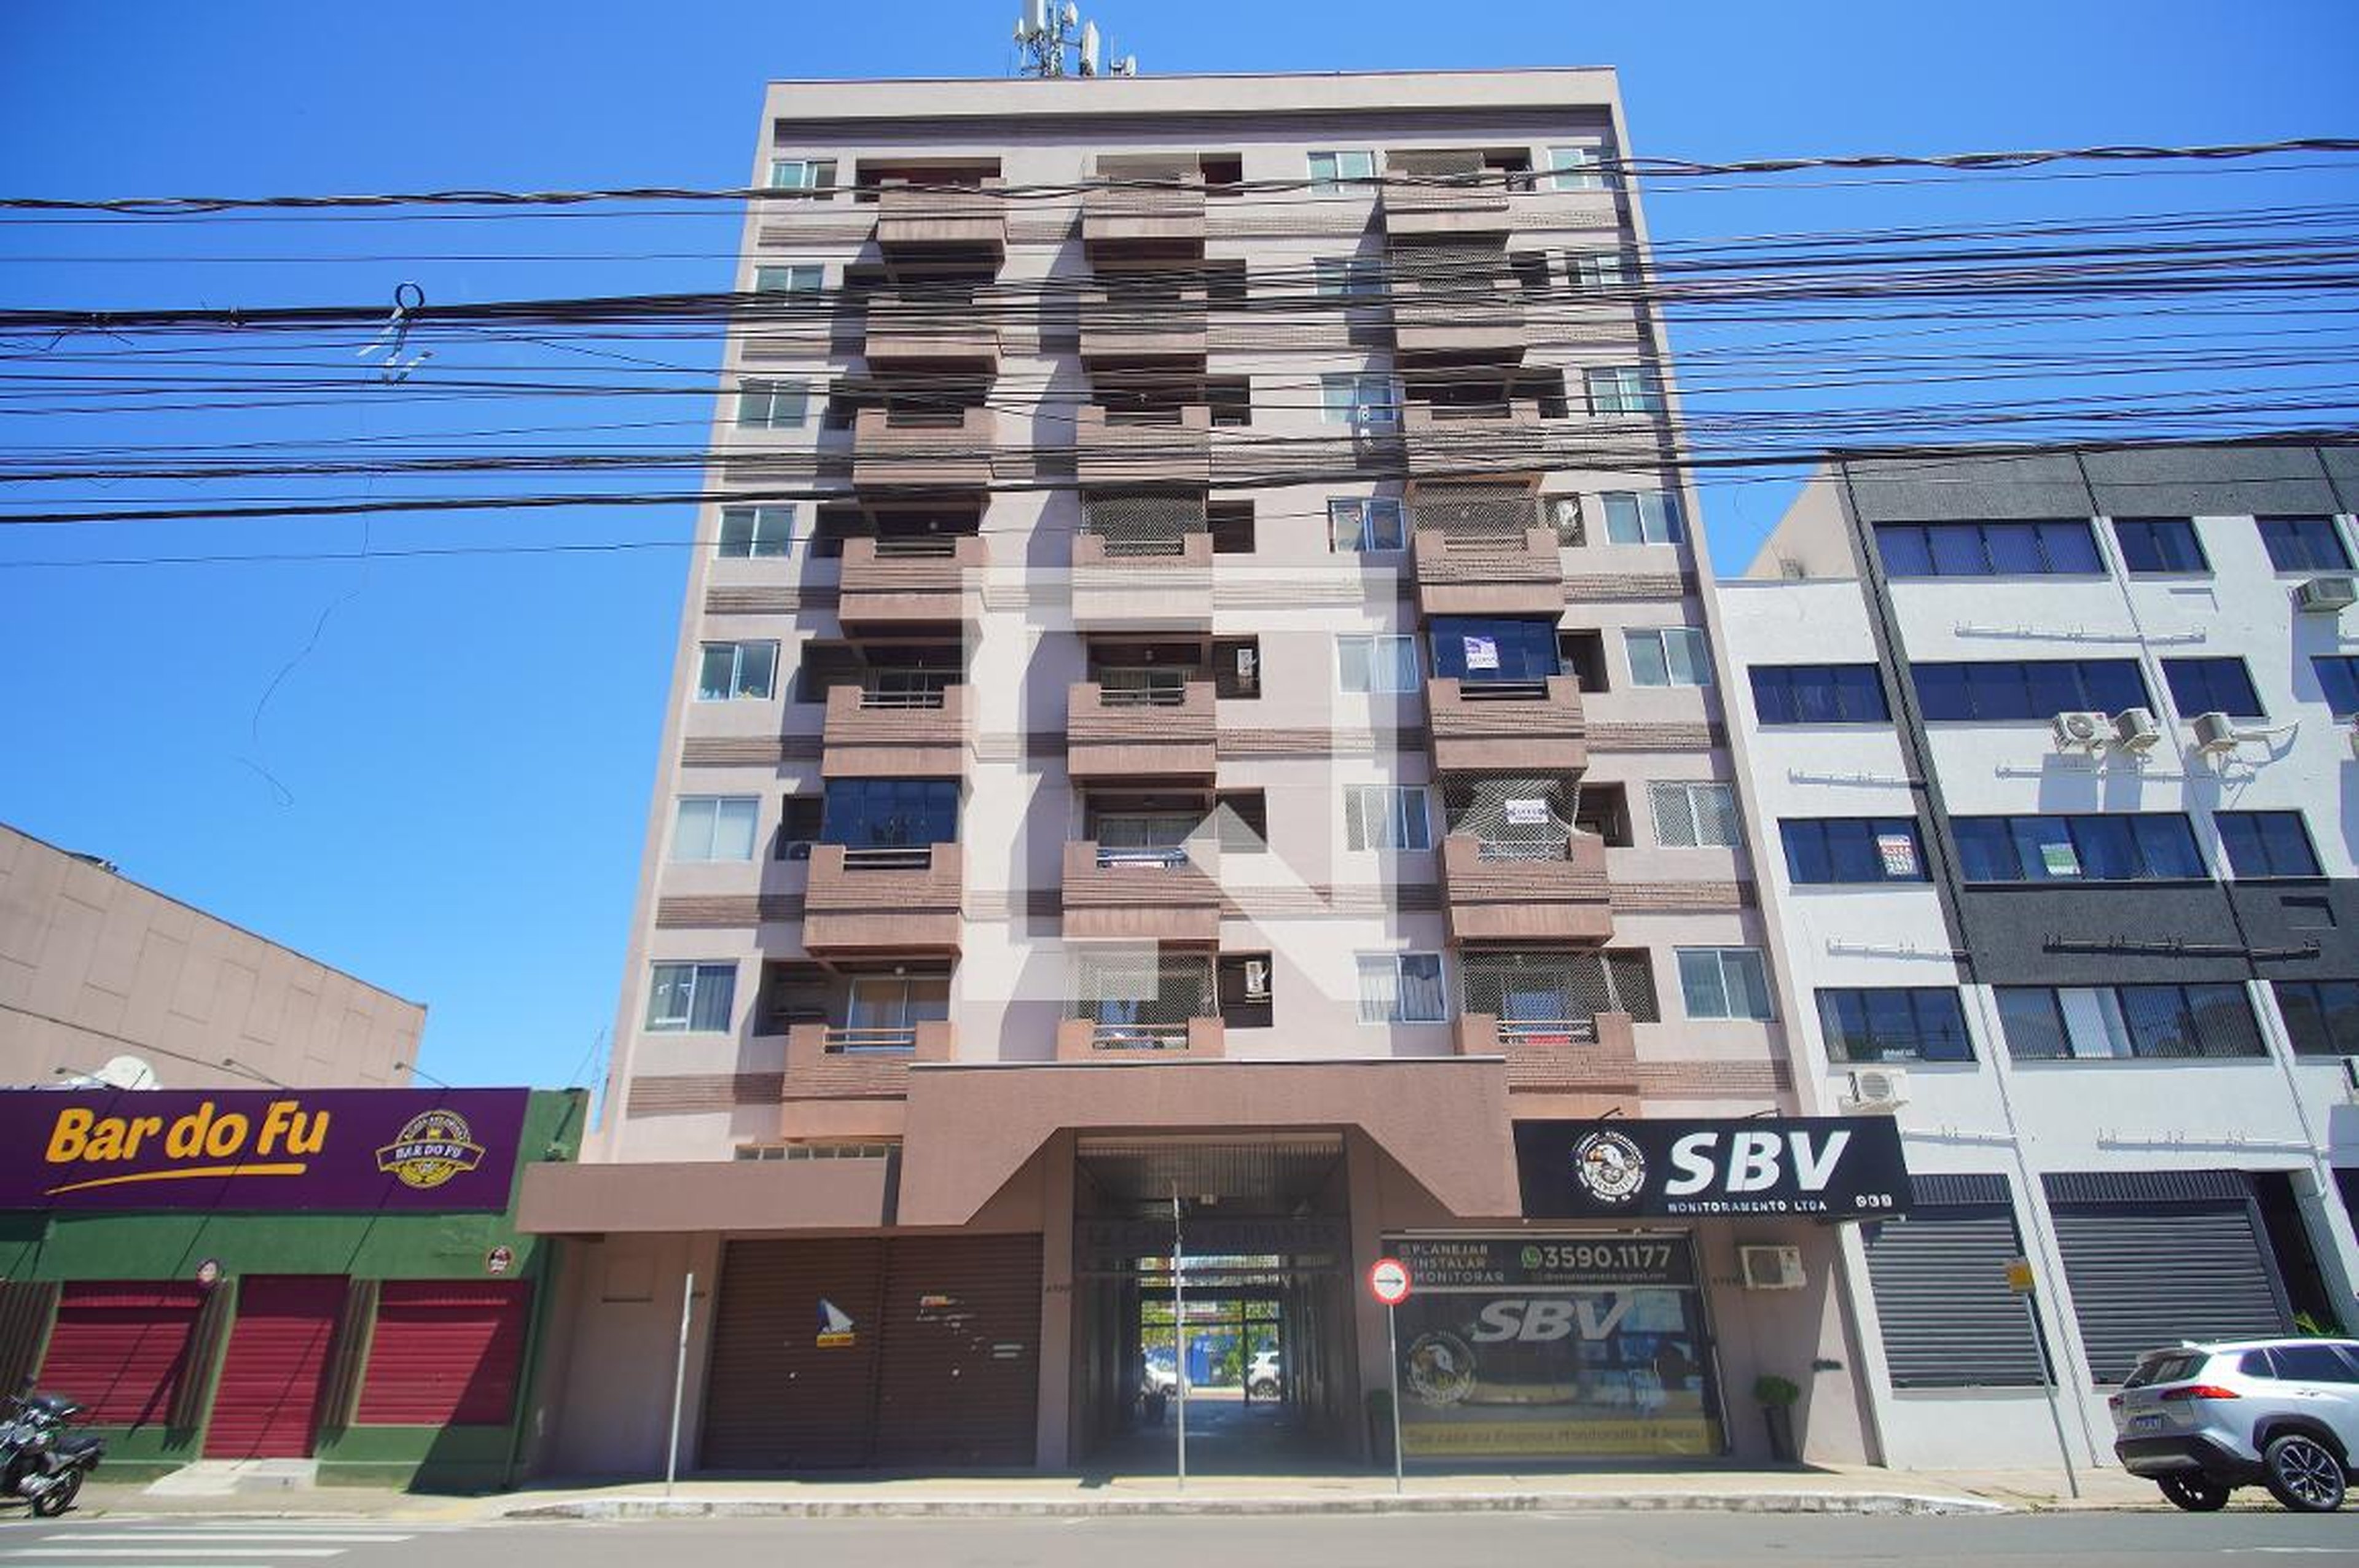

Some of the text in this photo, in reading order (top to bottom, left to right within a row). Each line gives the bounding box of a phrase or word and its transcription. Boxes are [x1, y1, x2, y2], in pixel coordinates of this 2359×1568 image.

[44, 1108, 163, 1163] Bar
[165, 1102, 248, 1159] do
[256, 1101, 331, 1155] Fu
[395, 1144, 464, 1160] BAR DO FU
[1665, 1131, 1850, 1196] SBV
[1668, 1201, 1828, 1213] MONITORAMENTO LTDA
[1412, 1244, 1488, 1255] PLANEJAR
[1544, 1246, 1671, 1268] 3590.1177
[1415, 1257, 1487, 1269] INSTALAR
[1414, 1271, 1504, 1282] MONITORAR
[1471, 1296, 1634, 1342] SBV
